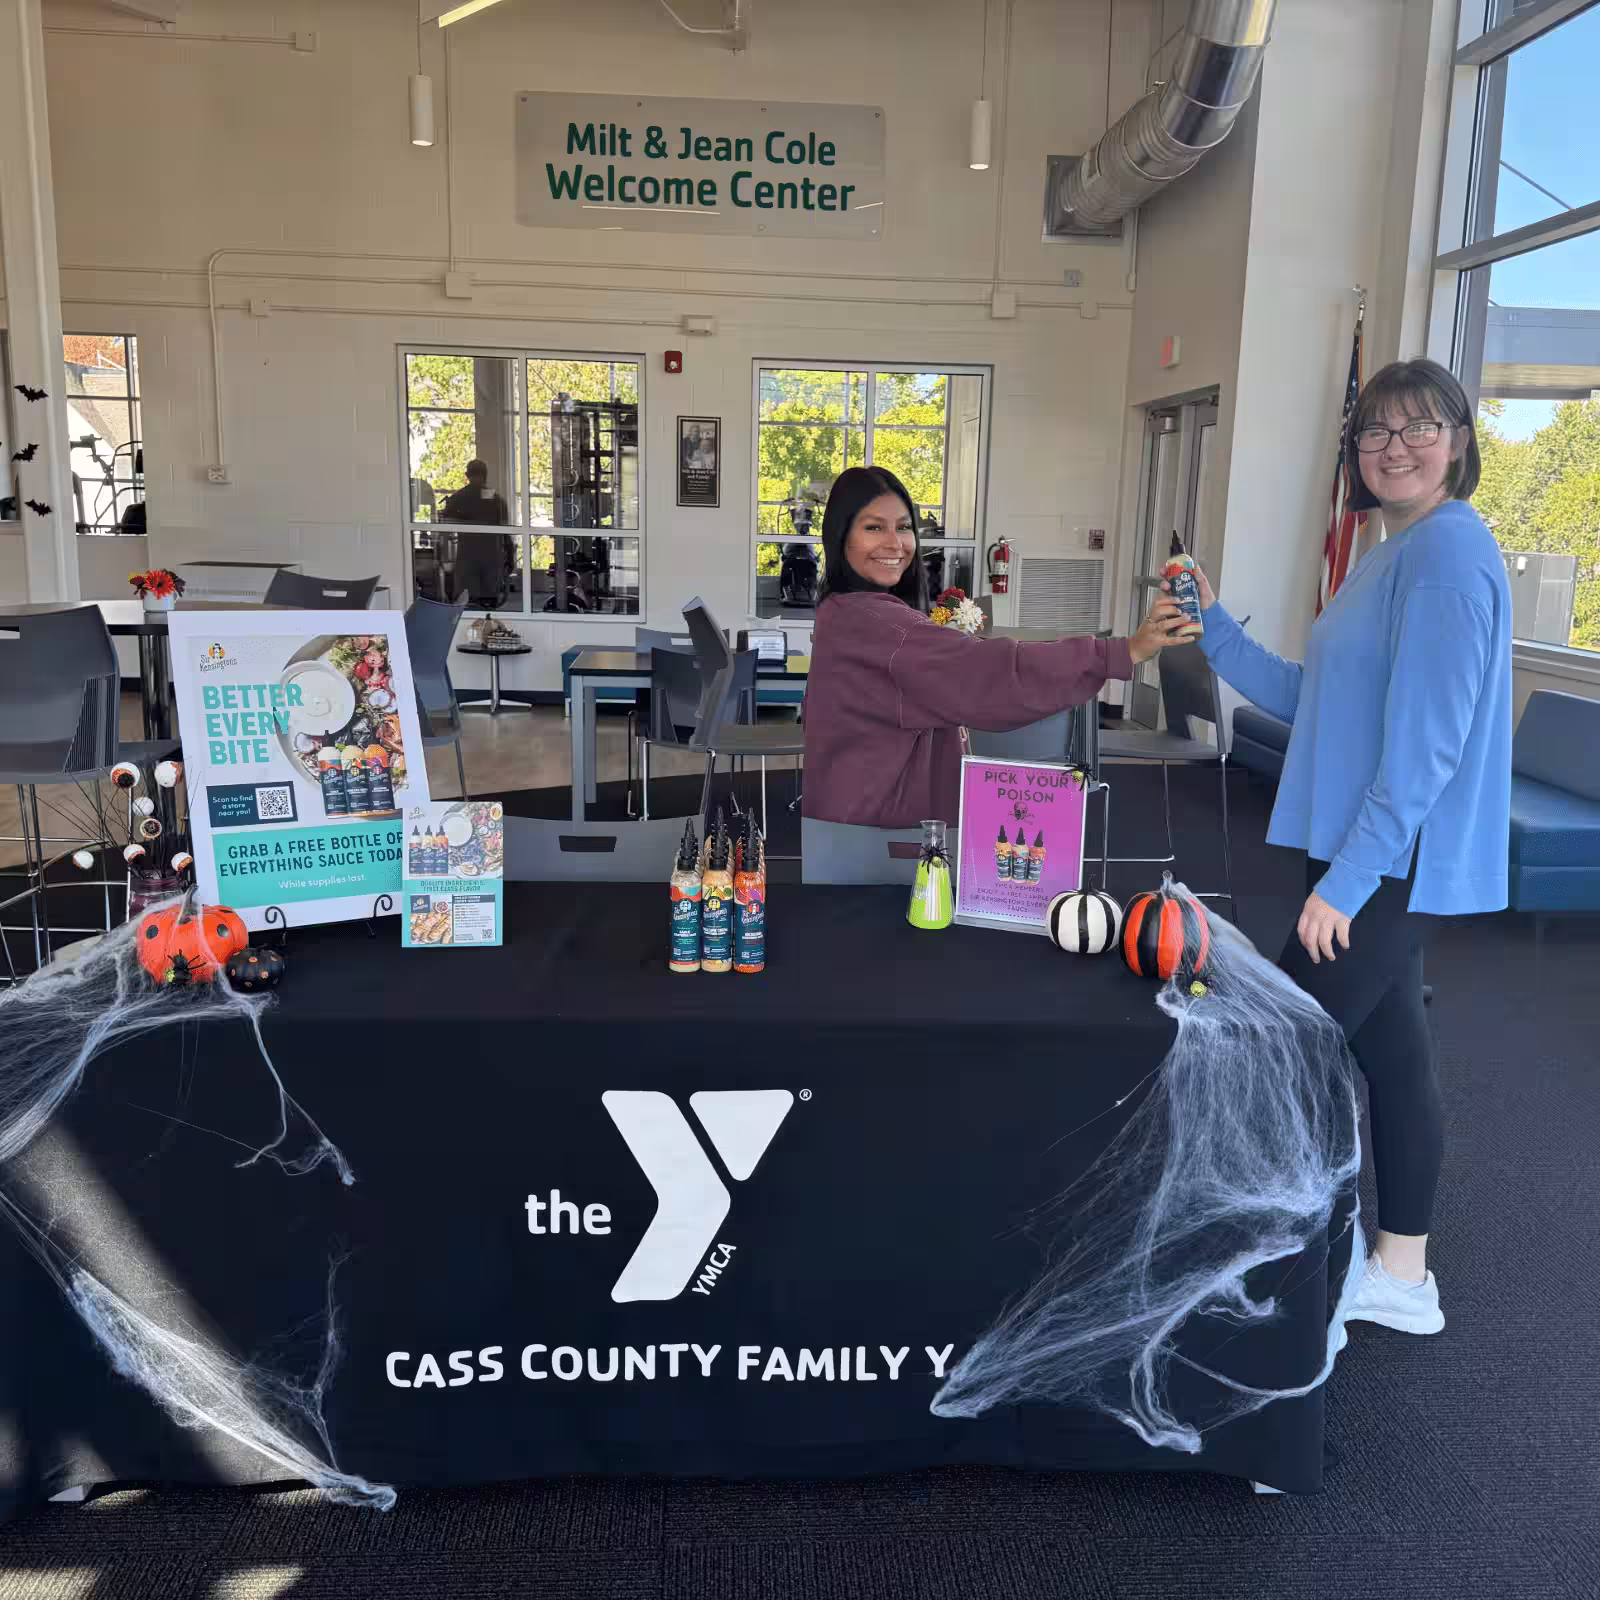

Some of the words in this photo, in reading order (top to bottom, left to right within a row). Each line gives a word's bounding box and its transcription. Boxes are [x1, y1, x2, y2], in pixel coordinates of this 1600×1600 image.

[566, 122, 632, 157] Milt
[643, 125, 668, 159] &
[677, 127, 753, 162] Jean
[765, 130, 836, 166] Cole
[545, 163, 717, 207] Welcome
[730, 171, 856, 211] Center
[202, 683, 304, 710] BETTER
[205, 710, 291, 737] EVERY
[208, 738, 270, 765] BITE
[984, 770, 1018, 785] PICK
[1025, 774, 1069, 789] YOUR
[212, 796, 230, 804] Scan
[239, 794, 254, 802] find
[997, 787, 1055, 803] POISON
[236, 808, 251, 816] you!
[228, 843, 269, 859] GRAB
[274, 842, 284, 856] A
[288, 838, 326, 854] FREE
[331, 833, 382, 850] BOTTLE
[386, 831, 403, 845] OF
[219, 855, 313, 877] EVERYTHING
[318, 851, 365, 868] SAUCE
[368, 847, 403, 863] TODA
[278, 878, 307, 889] While
[307, 874, 347, 887] supplies
[347, 873, 367, 882] last.
[994, 882, 1013, 890] YMCA
[524, 1188, 612, 1235] the
[691, 1242, 737, 1296] YMCA
[385, 1345, 504, 1388] CASS
[520, 1342, 722, 1382] COUNTY
[737, 1343, 910, 1382] FAMILY
[924, 1342, 955, 1379] Y
